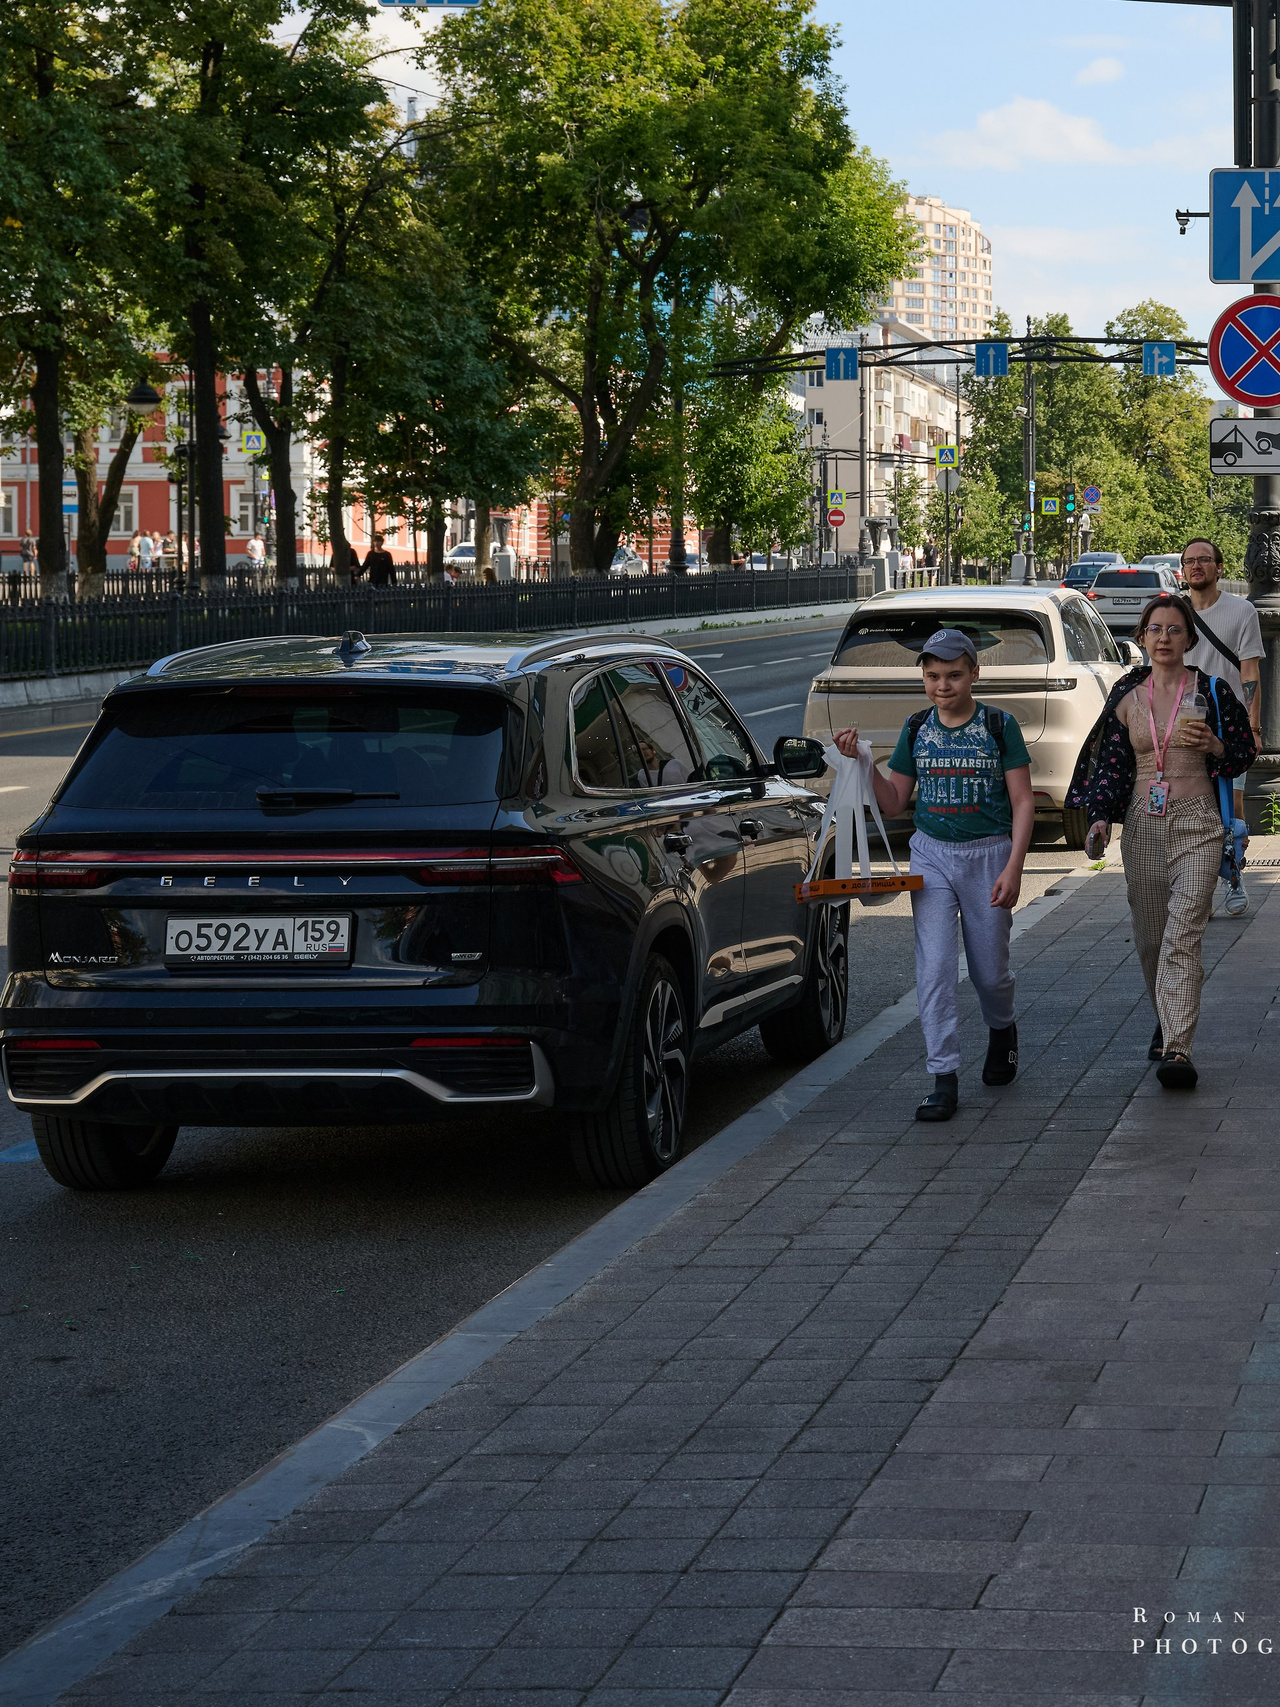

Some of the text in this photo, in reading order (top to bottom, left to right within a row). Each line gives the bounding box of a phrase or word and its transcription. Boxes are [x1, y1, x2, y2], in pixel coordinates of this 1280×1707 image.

[929, 749, 977, 757] PREMIUM
[954, 758, 998, 768] VARSITY
[920, 776, 994, 804] QUALITY
[160, 876, 352, 887] GEELY
[296, 920, 341, 943] 159
[305, 943, 327, 951] RUS
